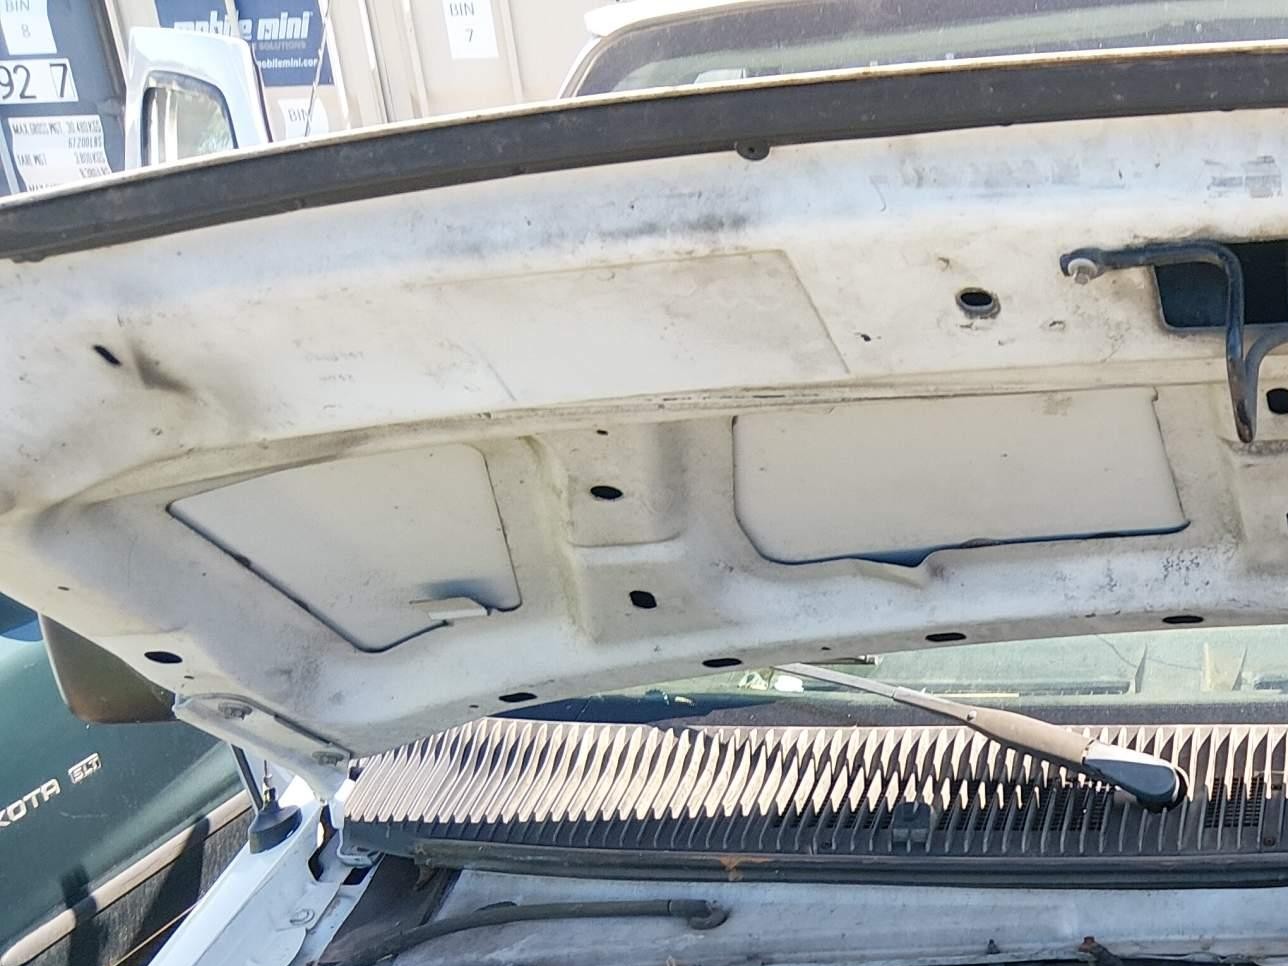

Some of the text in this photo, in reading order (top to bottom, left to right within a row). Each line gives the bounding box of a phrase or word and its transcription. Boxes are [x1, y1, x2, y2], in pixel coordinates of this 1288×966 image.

[5, 0, 30, 12] BIN
[449, 2, 475, 16] BIN
[21, 24, 31, 38] 8
[257, 11, 313, 40] mini
[465, 27, 474, 42] 7
[69, 753, 101, 784] SLT
